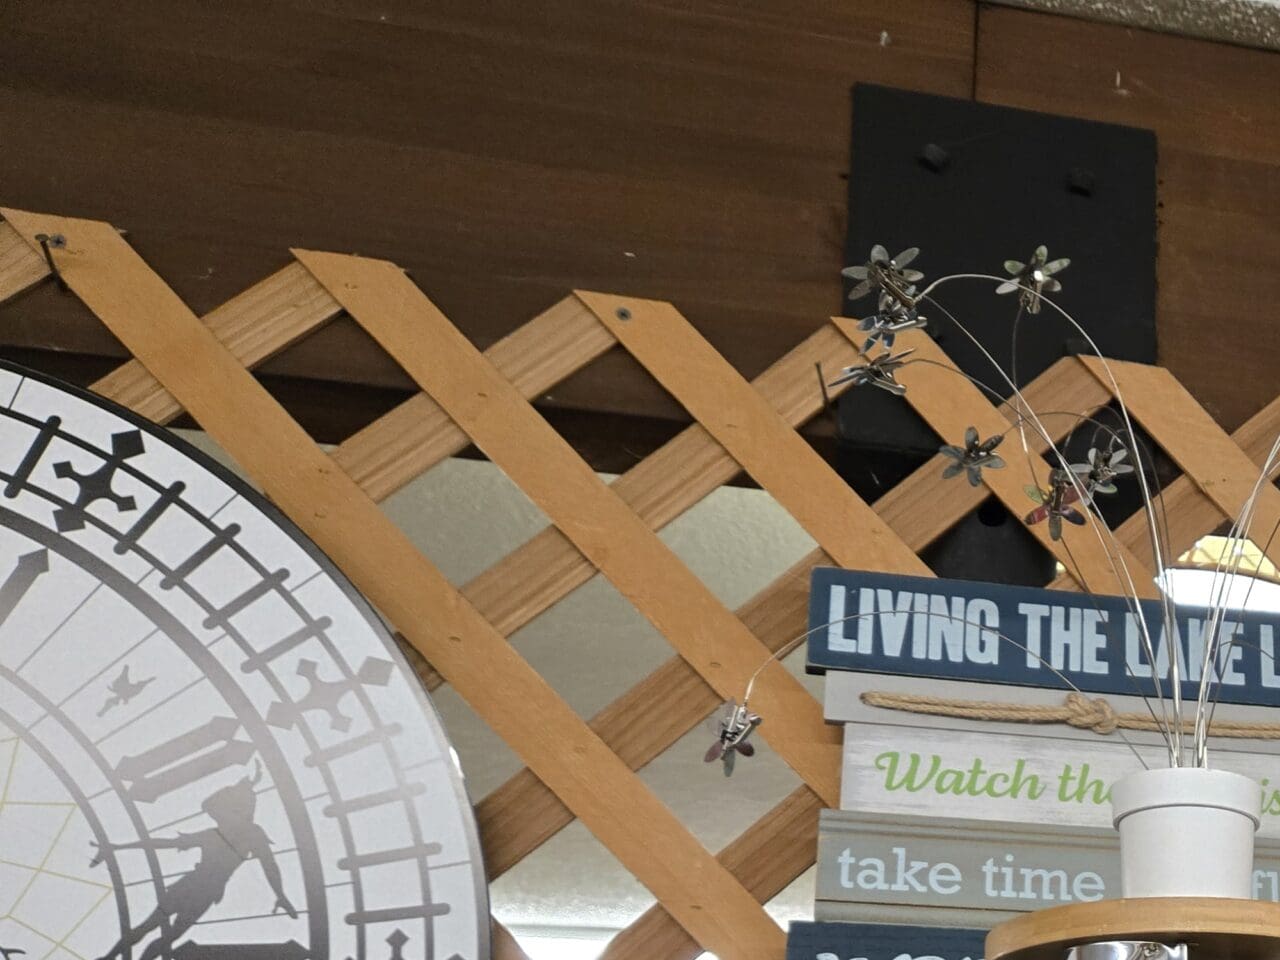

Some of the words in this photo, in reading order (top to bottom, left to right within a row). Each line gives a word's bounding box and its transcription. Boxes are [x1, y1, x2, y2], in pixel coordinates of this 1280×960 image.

[828, 584, 1000, 666] LIVING
[1019, 602, 1110, 675] THE
[1124, 612, 1246, 686] LAKE
[874, 750, 1047, 802] Watch
[838, 847, 962, 895] take
[981, 853, 1106, 903] time
